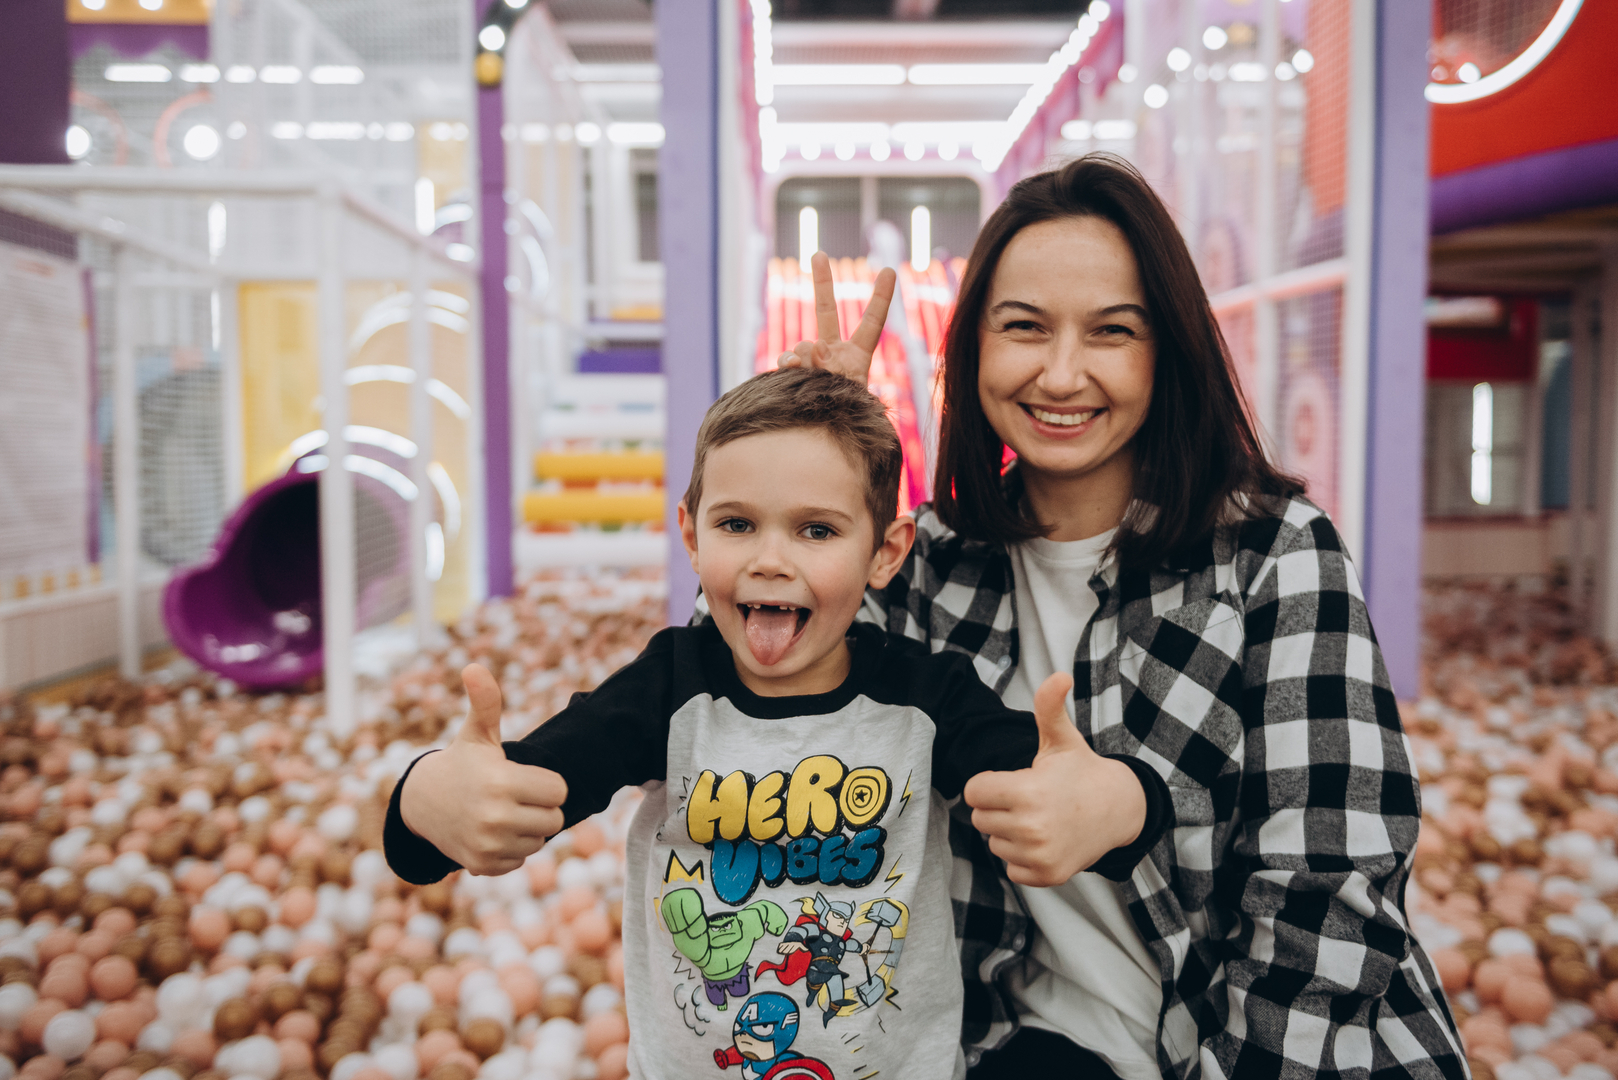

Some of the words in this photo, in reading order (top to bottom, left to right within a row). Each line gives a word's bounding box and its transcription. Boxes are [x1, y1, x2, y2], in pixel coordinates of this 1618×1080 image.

[686, 754, 892, 846] HERO
[711, 825, 887, 906] VIBES
[740, 1001, 759, 1022] A
